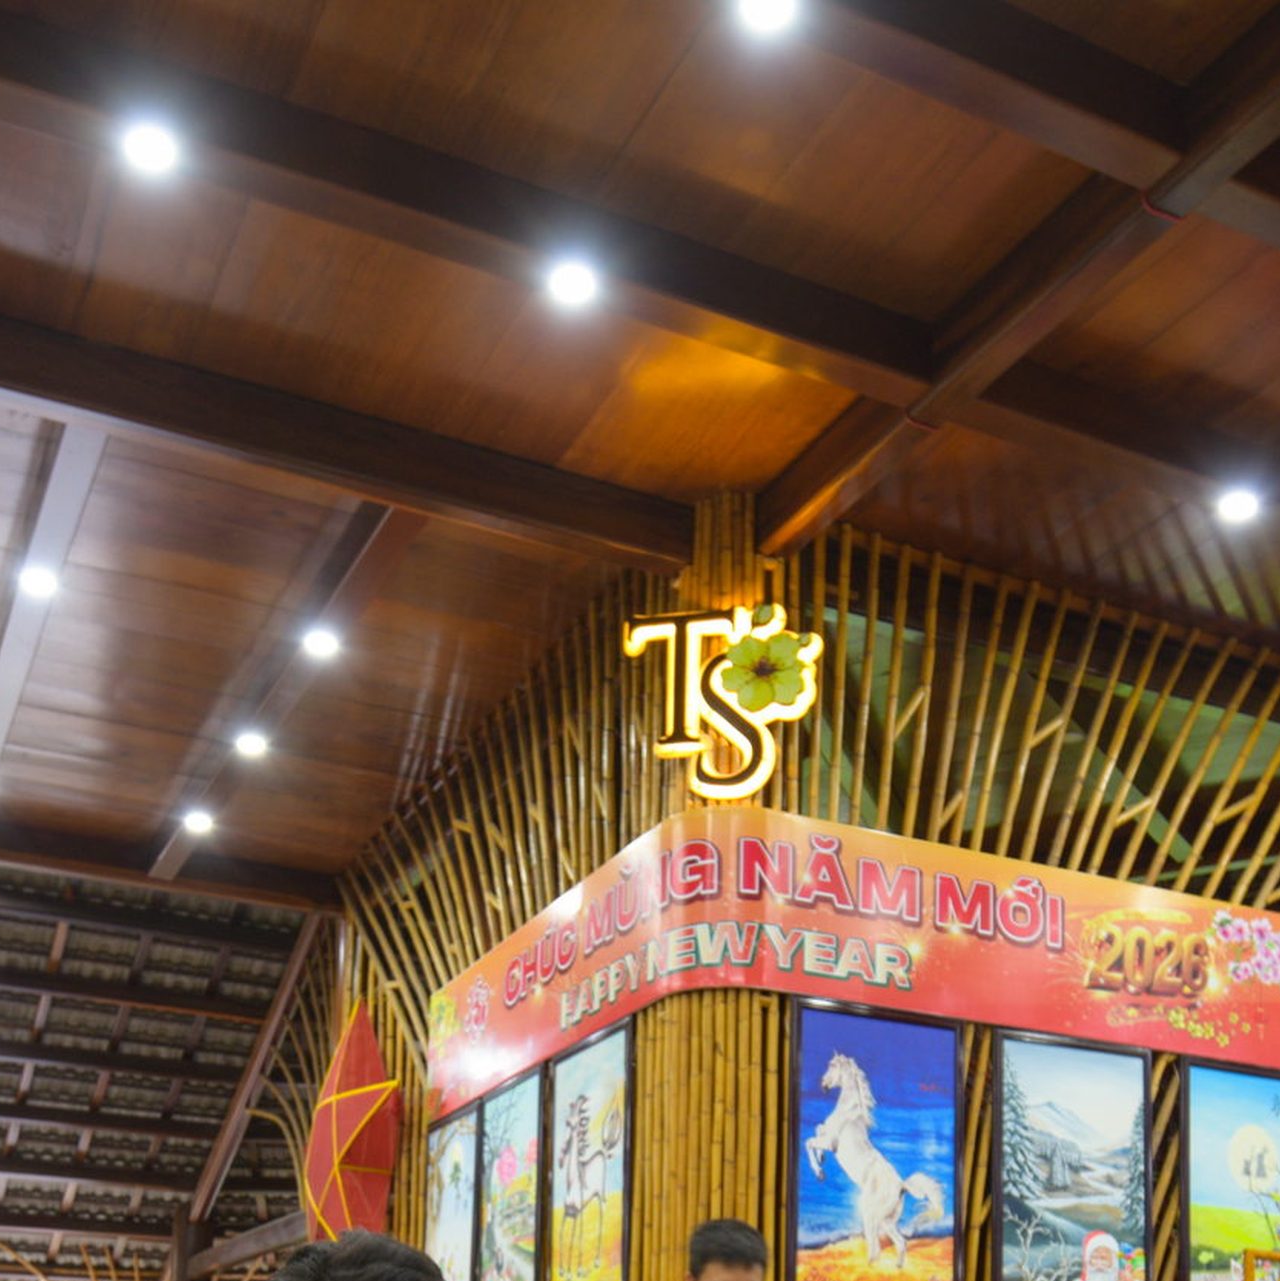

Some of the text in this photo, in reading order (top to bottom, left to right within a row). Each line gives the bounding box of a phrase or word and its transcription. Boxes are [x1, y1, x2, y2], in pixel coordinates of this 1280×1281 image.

[504, 921, 577, 1008] CHÚC
[737, 834, 921, 924] NĂM
[934, 871, 1064, 950] MỚI
[559, 921, 912, 1031] HAPPY NEW YEAR
[1084, 922, 1208, 998] 2026
